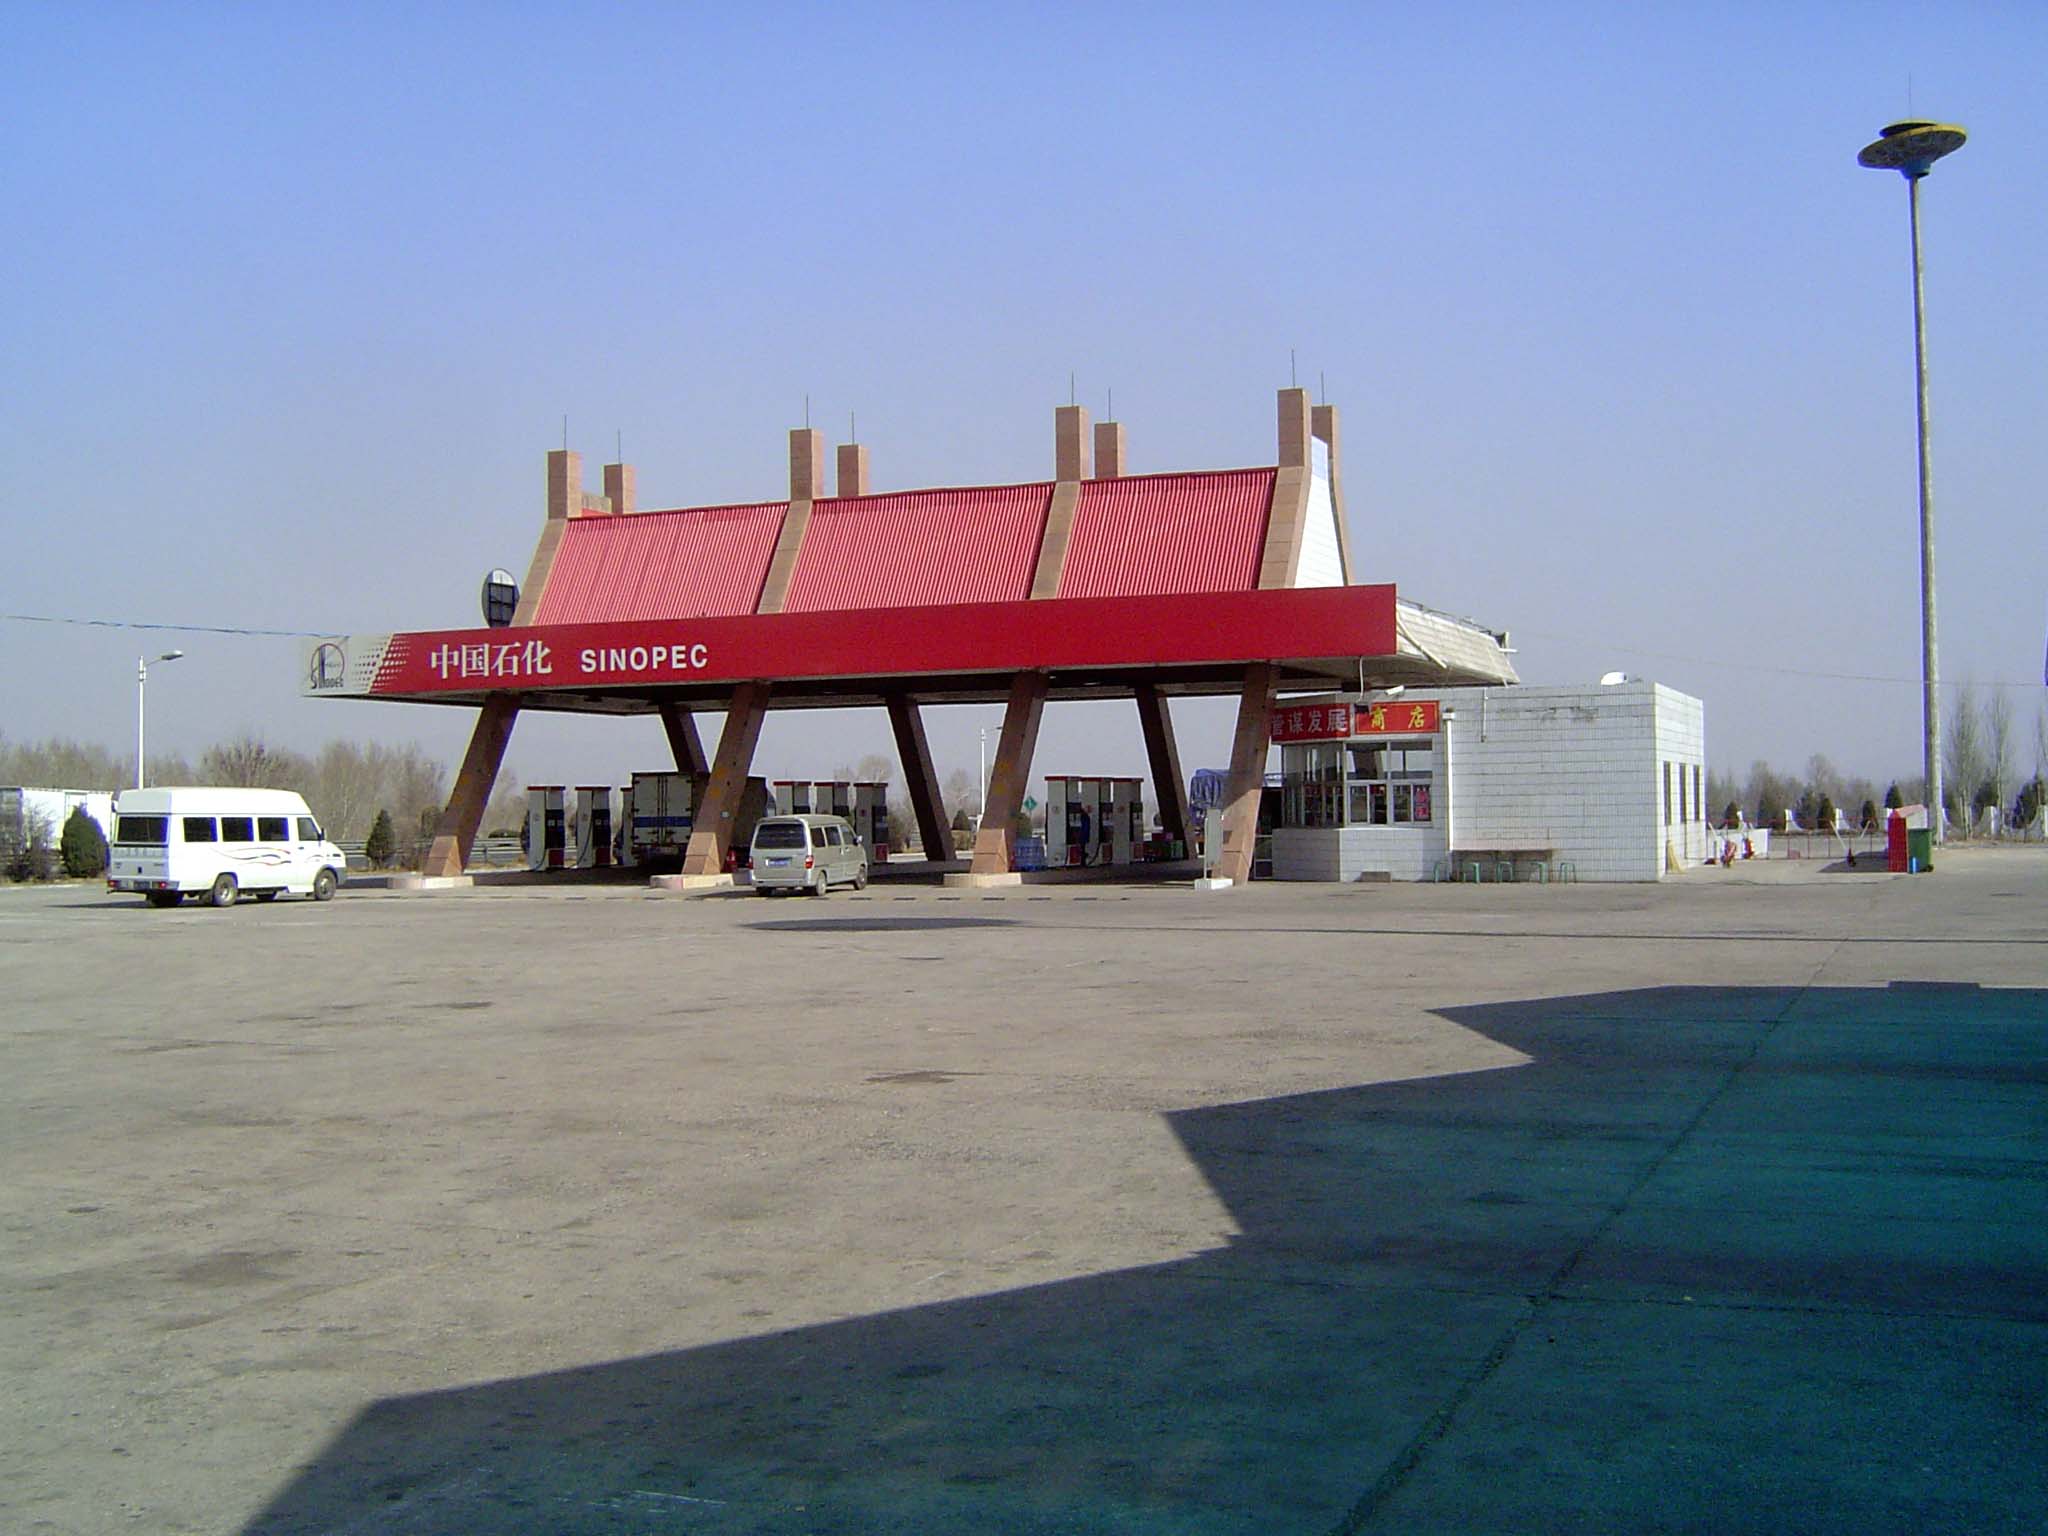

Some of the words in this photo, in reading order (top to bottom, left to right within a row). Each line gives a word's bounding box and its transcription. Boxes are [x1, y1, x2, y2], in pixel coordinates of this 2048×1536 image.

[431, 640, 552, 679] 中国石化
[581, 645, 708, 673] SINOPEC
[1370, 706, 1425, 731] 商店
